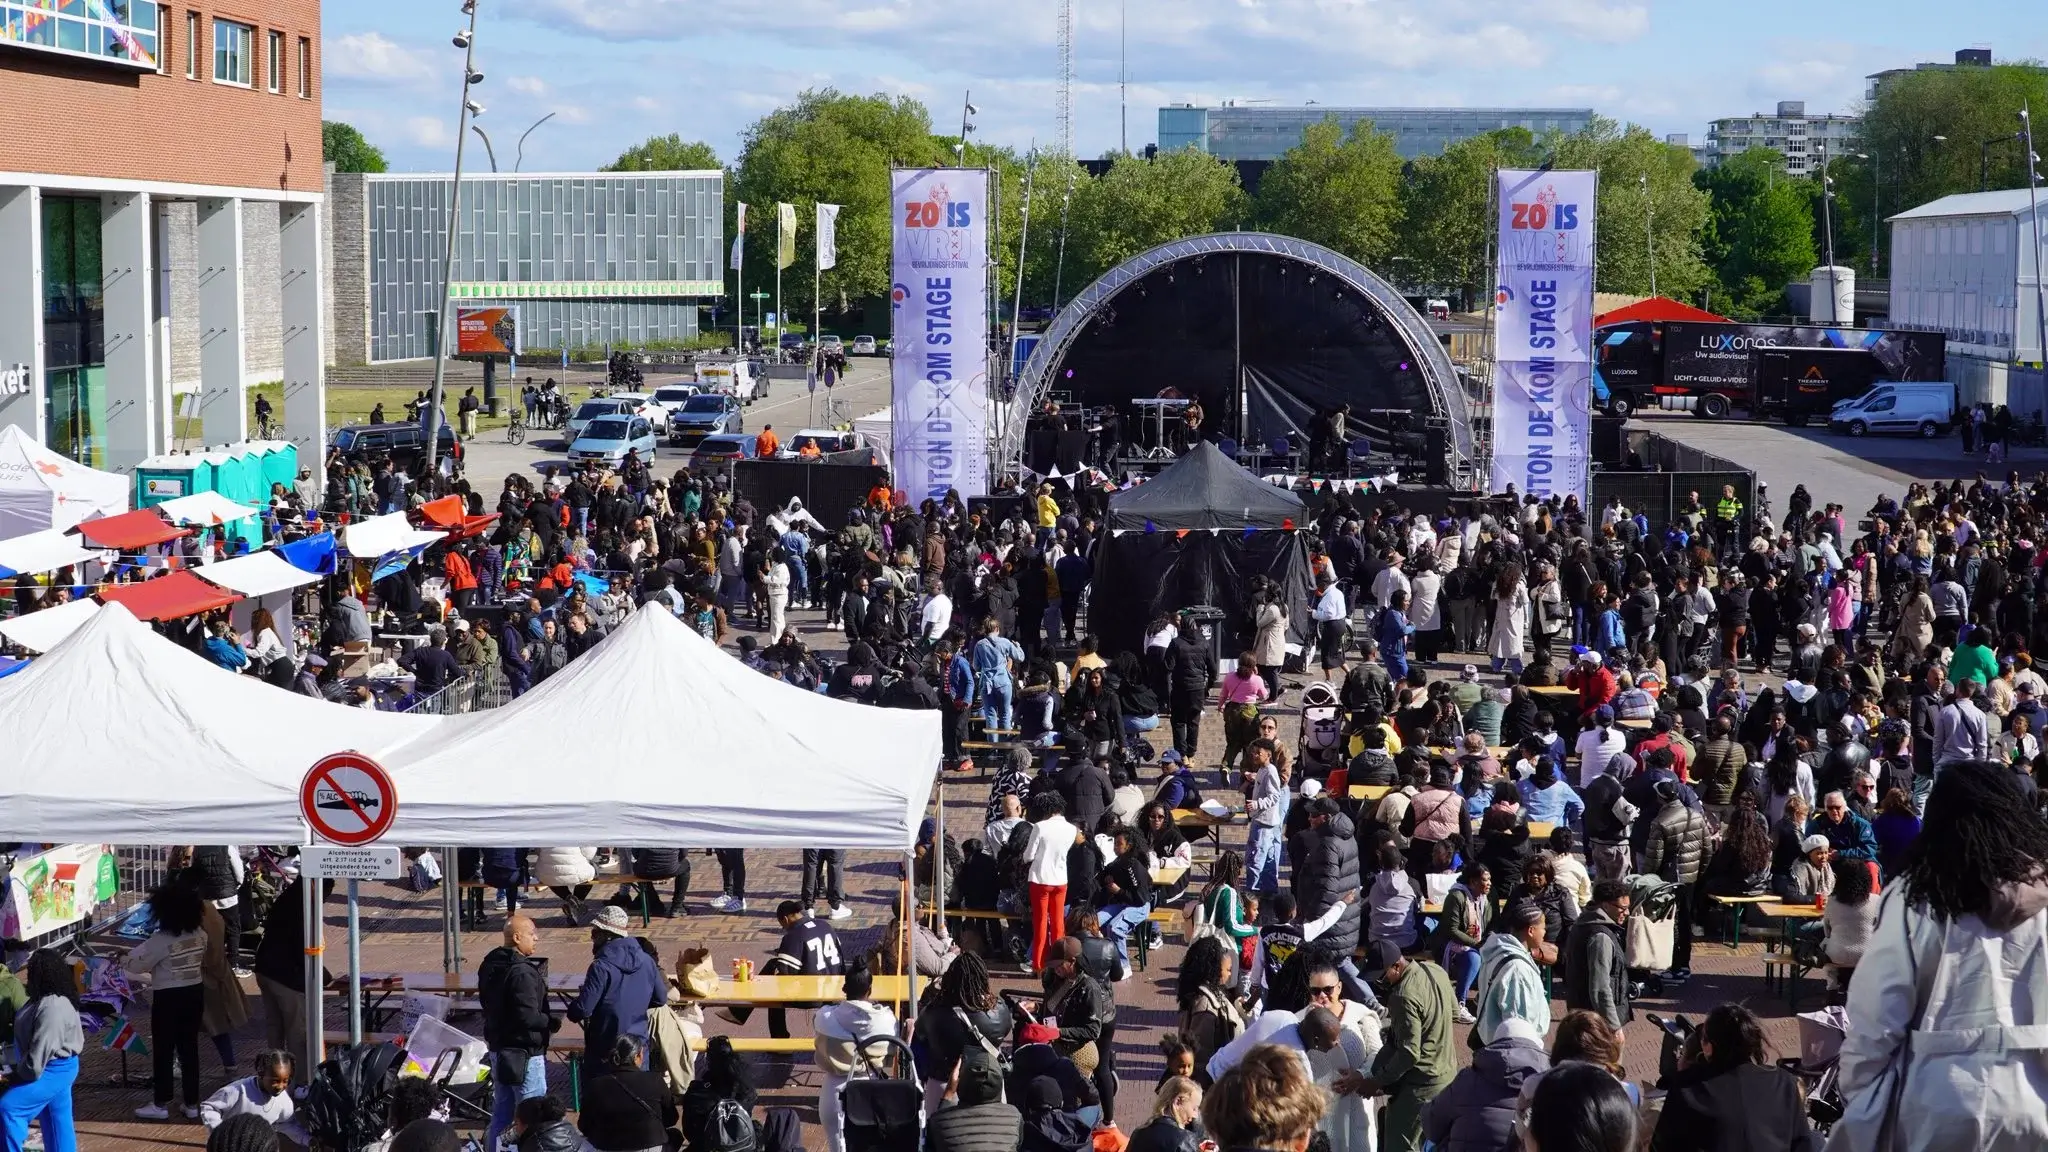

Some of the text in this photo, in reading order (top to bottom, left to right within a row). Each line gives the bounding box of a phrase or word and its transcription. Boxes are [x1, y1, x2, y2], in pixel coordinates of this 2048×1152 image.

[905, 202, 971, 228] ZO IS
[1511, 204, 1578, 230] ZO IS
[926, 277, 952, 346] STAGE
[1529, 279, 1557, 349] STAGE
[1695, 351, 1749, 361] Uw audiovisuel
[1528, 356, 1555, 403] KOM
[1674, 374, 1748, 384] LICHT GELUID VIDEO
[1527, 410, 1554, 437] DE
[927, 441, 953, 504] NTON
[806, 933, 840, 971] 74
[1263, 931, 1302, 946] PIKACHU
